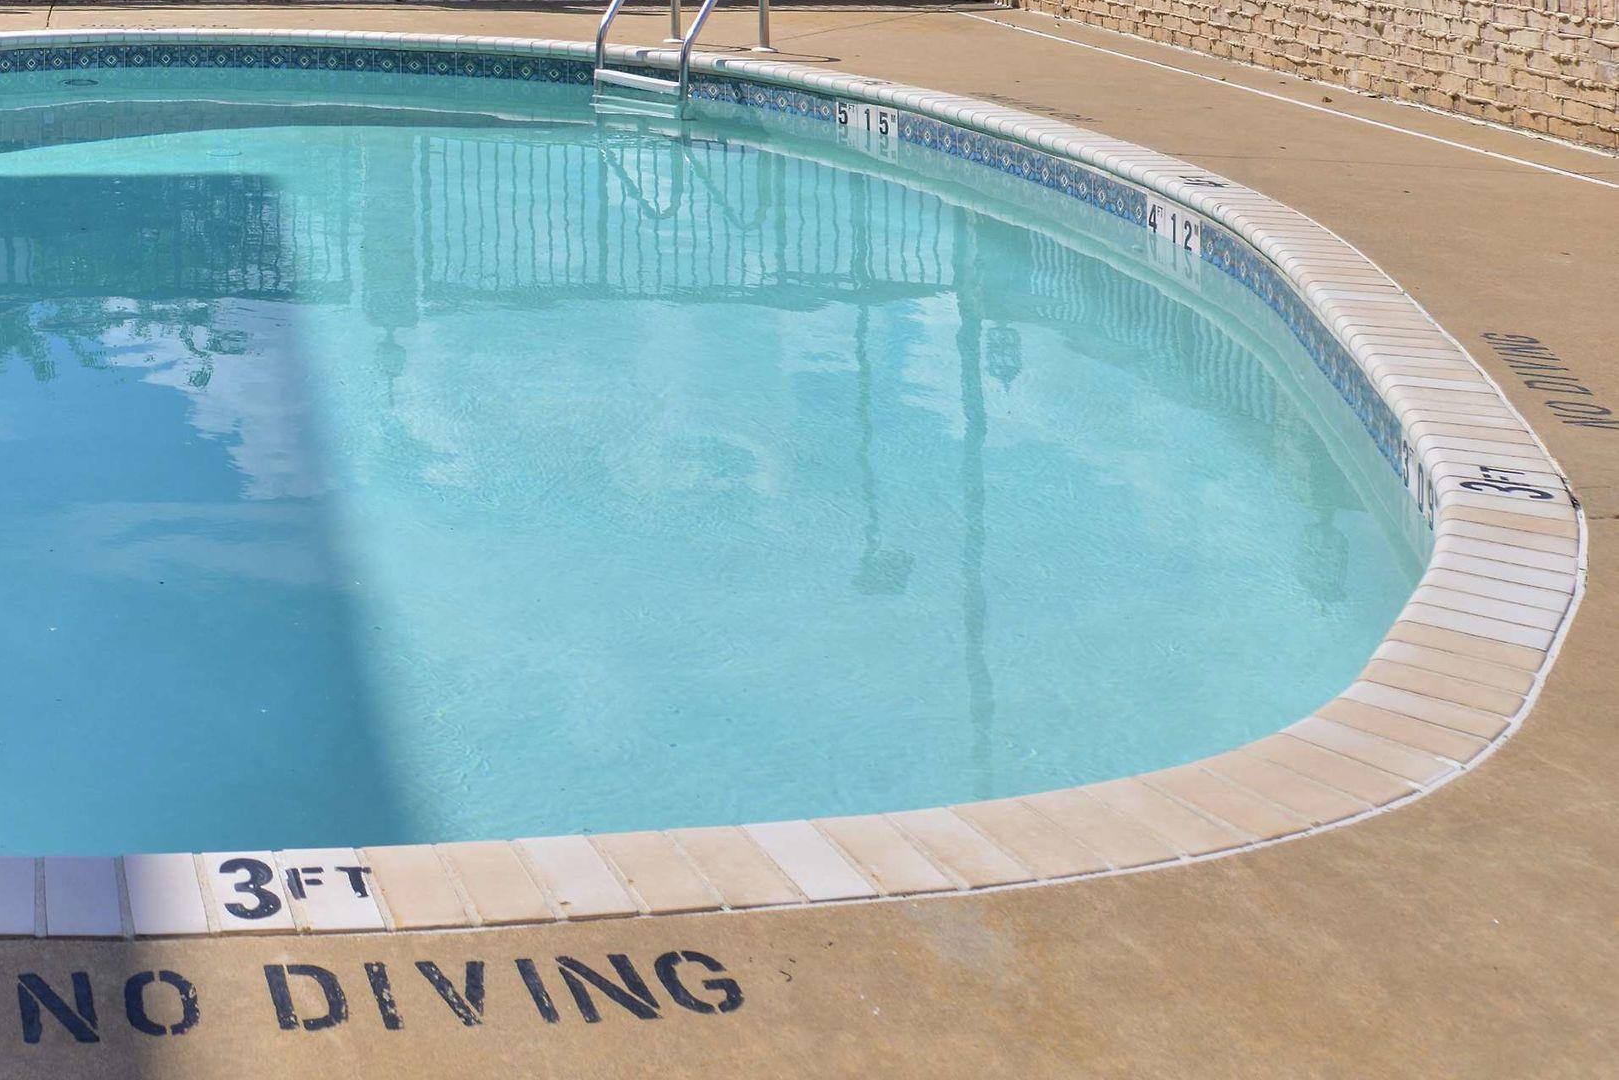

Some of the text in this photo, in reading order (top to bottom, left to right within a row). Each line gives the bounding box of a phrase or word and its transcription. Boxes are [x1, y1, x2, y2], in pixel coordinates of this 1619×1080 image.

[1480, 332, 1594, 396] DIVING
[18, 950, 746, 1044] NO DIVING
